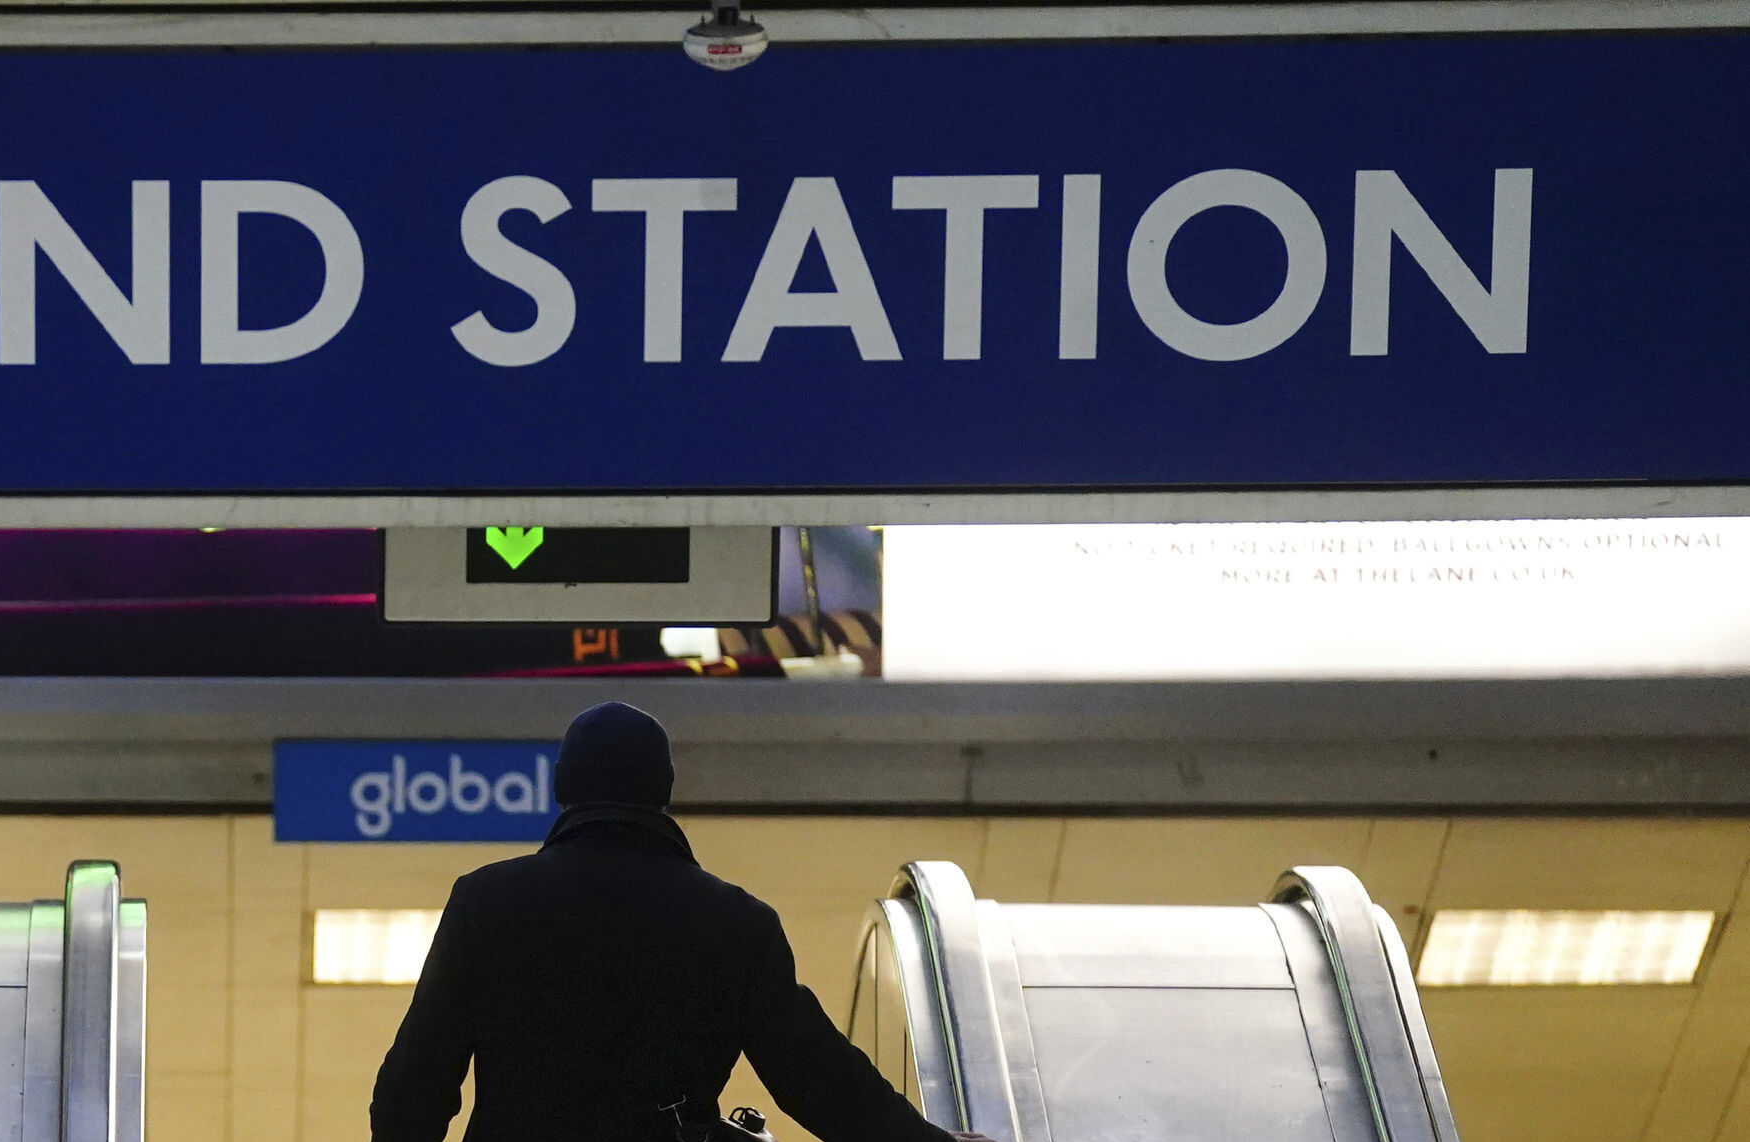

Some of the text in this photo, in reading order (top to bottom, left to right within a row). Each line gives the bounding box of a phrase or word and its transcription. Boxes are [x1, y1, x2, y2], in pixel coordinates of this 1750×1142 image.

[451, 168, 1533, 367] STATION
[1582, 532, 1726, 550] OPTIONAL
[1220, 567, 1294, 583] MORE
[1311, 567, 1340, 583] AT
[350, 754, 550, 837] global
